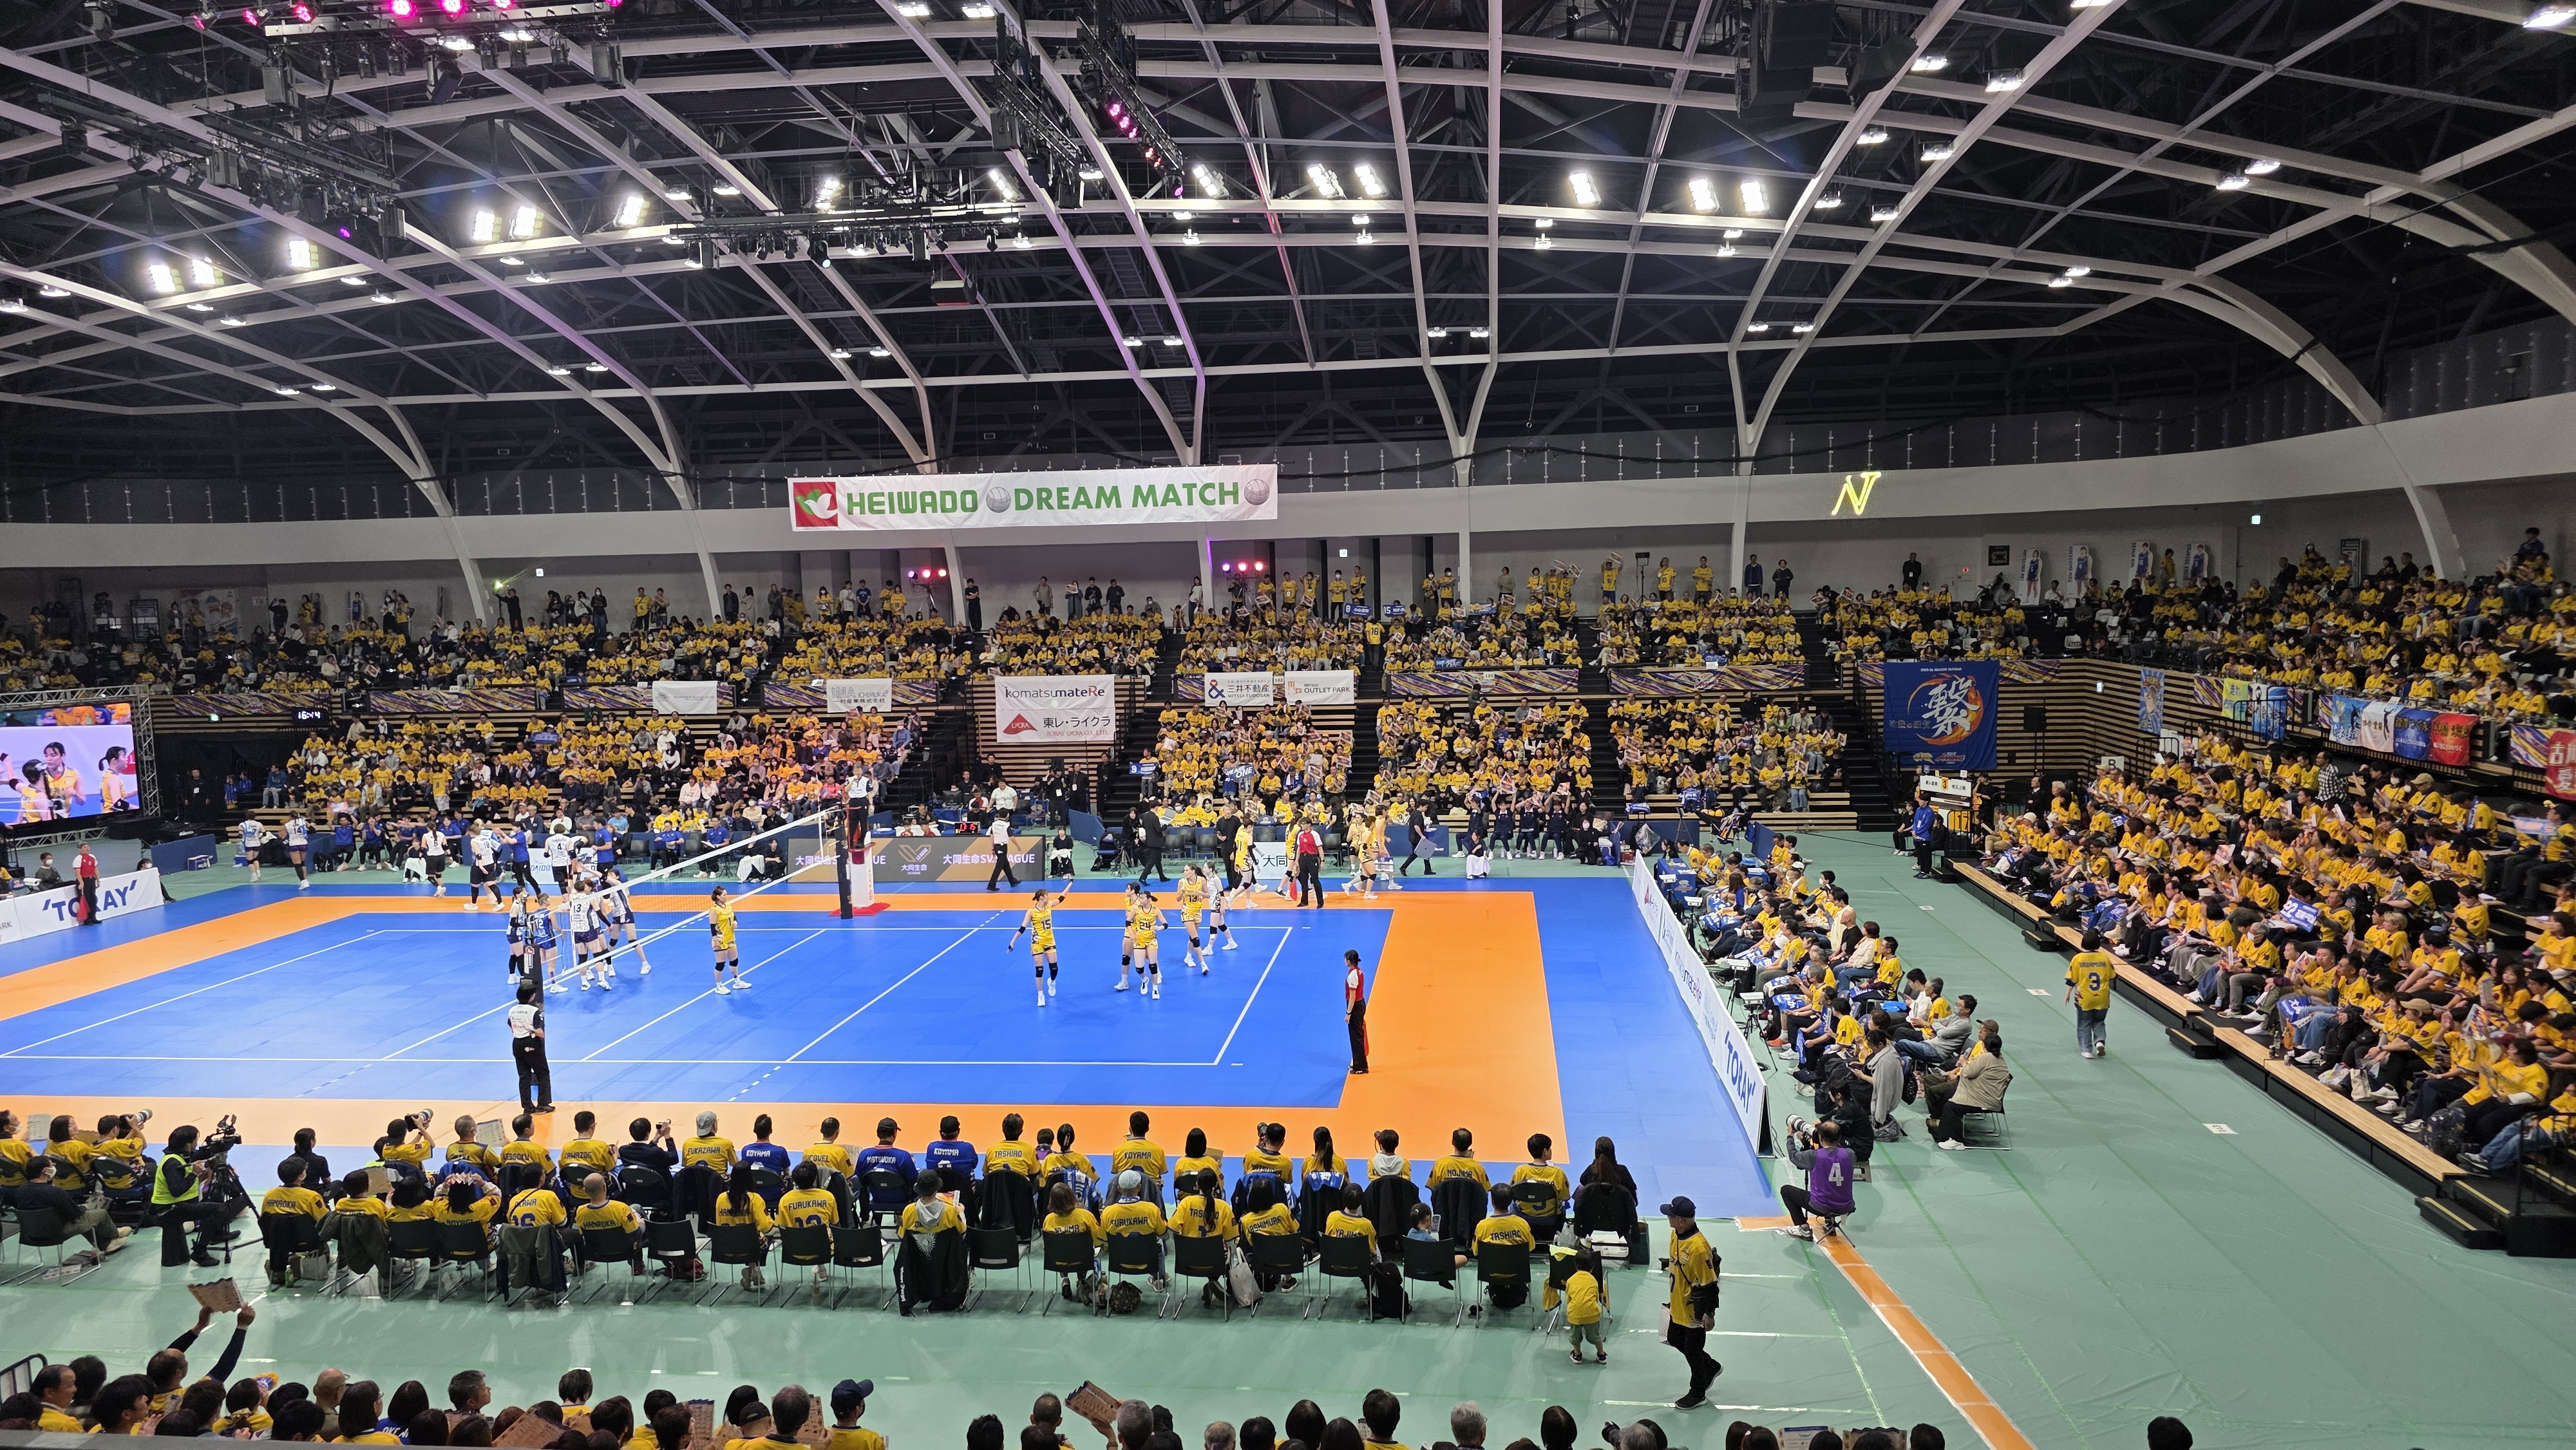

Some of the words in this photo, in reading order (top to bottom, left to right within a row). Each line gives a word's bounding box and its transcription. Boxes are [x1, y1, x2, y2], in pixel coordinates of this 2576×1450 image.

[848, 489, 978, 514] HEIWADO
[1015, 485, 1122, 511] DREAM
[1132, 482, 1239, 507] MATCH
[831, 687, 856, 698] IMA
[1005, 686, 1105, 698] komatsumateRe
[1227, 684, 1270, 693] 三井不動産
[1043, 716, 1111, 728] 東レ・ライクラ
[1943, 780, 1947, 789] 3
[1041, 919, 1051, 930] 15
[1139, 922, 1151, 930] 24
[2088, 972, 2101, 992] 3
[934, 1147, 960, 1156] KOYAMA
[1124, 1151, 1151, 1160] KOYAMA
[1828, 1162, 1844, 1187] 4
[267, 1199, 296, 1209] HANAOKA
[788, 1200, 827, 1210] FURUKAWA
[1111, 1216, 1148, 1227] FURUKAWA
